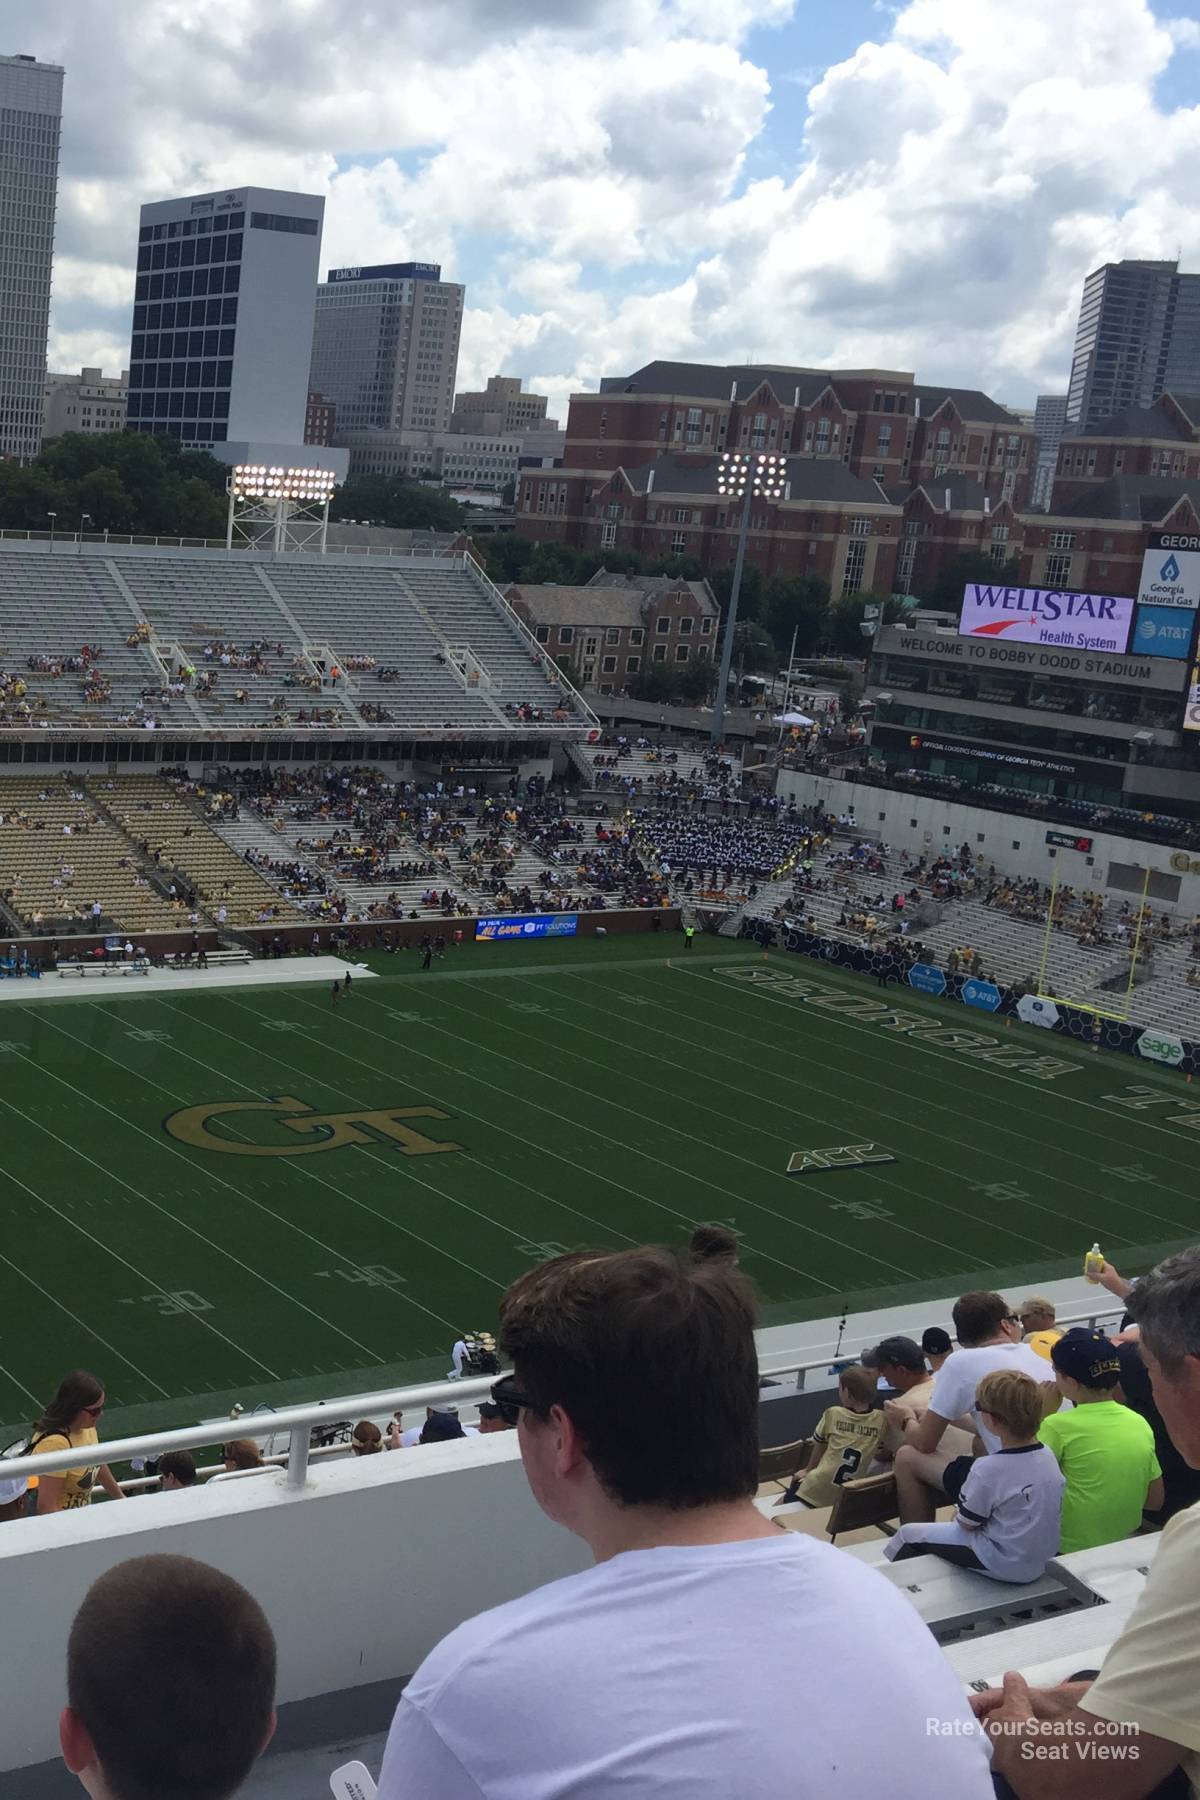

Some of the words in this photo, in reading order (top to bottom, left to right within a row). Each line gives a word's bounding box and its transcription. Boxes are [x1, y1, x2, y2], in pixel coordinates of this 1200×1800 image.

[336, 268, 362, 280] EMORY
[416, 263, 439, 273] EMORY
[1142, 594, 1174, 604] Natural
[1176, 596, 1193, 606] Gas
[1151, 583, 1185, 597] Georgia
[974, 585, 1117, 621] WELLSTAR
[1040, 629, 1075, 646] Health
[1076, 633, 1117, 650] System
[1158, 626, 1189, 640] AT&T
[900, 637, 963, 656] WELCOME
[968, 645, 984, 658] TO
[989, 648, 1035, 665] BOBBY
[1040, 654, 1080, 670] DODD
[1085, 660, 1151, 679] STADIUM
[1005, 755, 1029, 765] GEORGIA
[545, 922, 577, 930] SOLUTIONS
[977, 992, 997, 1003] AT&T
[713, 965, 1085, 1080] GEORGIA
[1141, 1037, 1180, 1059] sage
[162, 1093, 470, 1158] GT
[786, 1143, 895, 1173] ACC
[336, 1264, 408, 1287] 40
[140, 1289, 215, 1316] 30
[836, 1420, 855, 1434] YELLOW
[857, 1422, 879, 1438] JACKETS
[832, 1448, 863, 1486] 2
